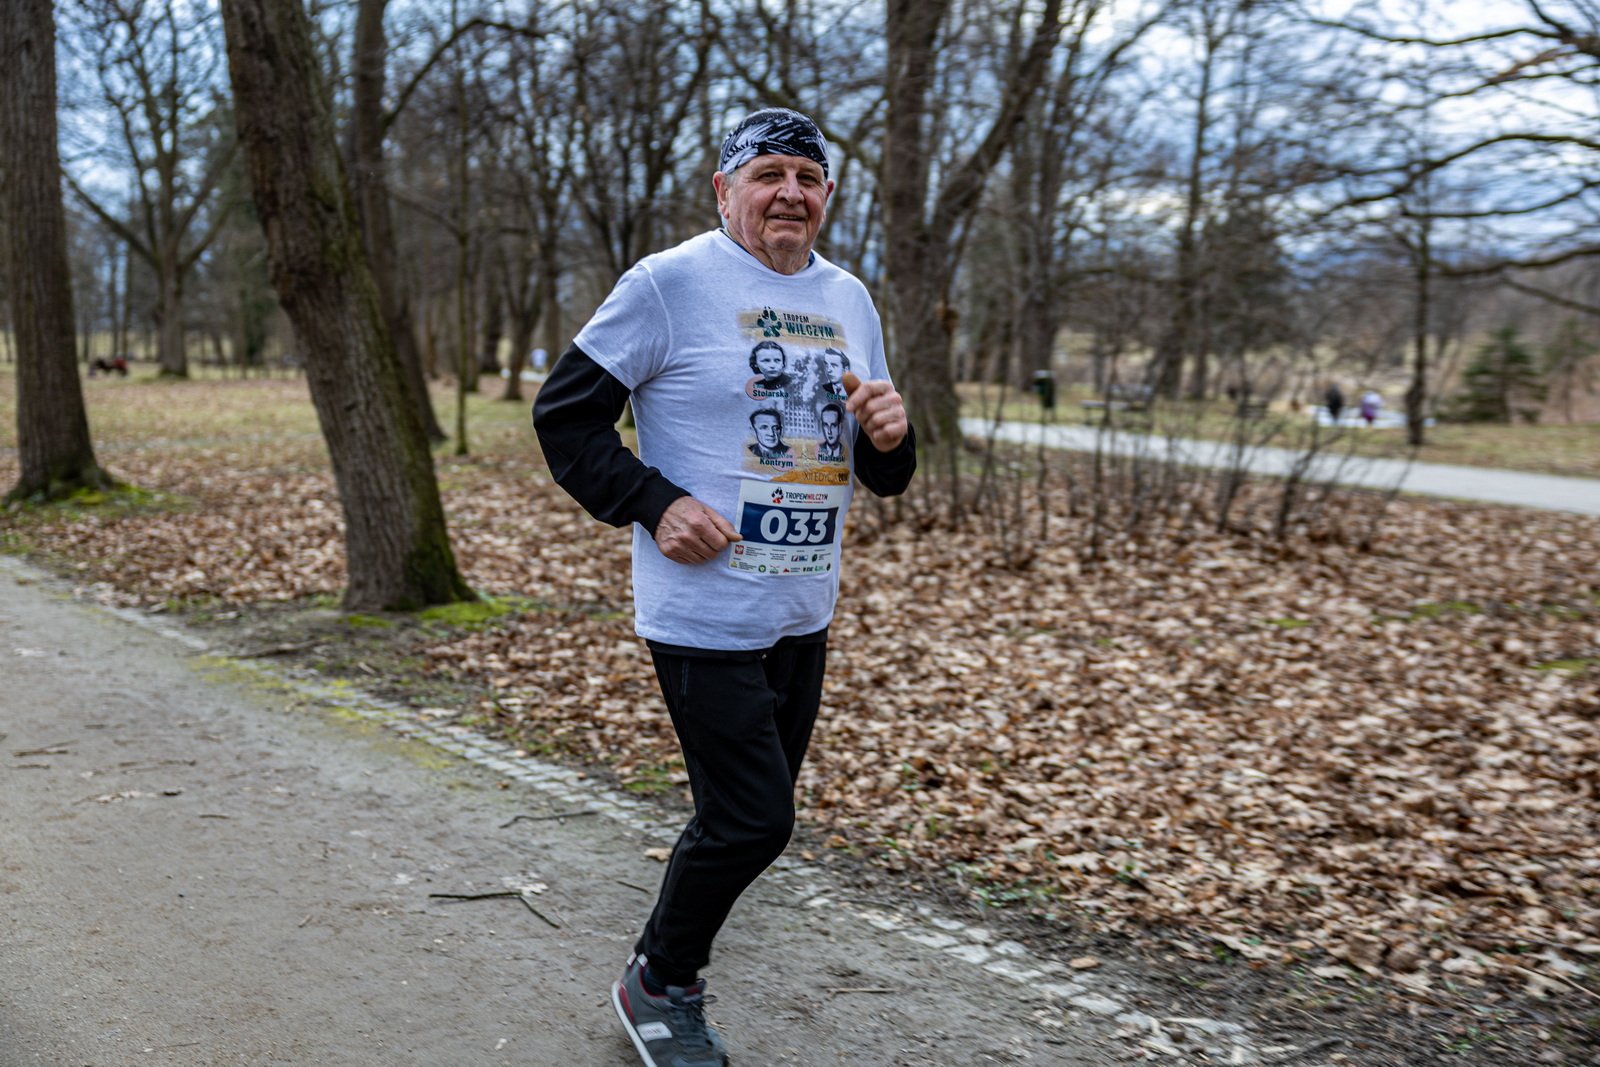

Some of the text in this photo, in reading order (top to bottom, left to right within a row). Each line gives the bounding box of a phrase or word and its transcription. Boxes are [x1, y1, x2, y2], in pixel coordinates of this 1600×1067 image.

[783, 313, 810, 323] TROPEM
[785, 322, 835, 338] WILCZYM
[753, 389, 789, 398] Stolarska
[760, 458, 793, 468] Kontrym
[760, 508, 829, 544] 033
